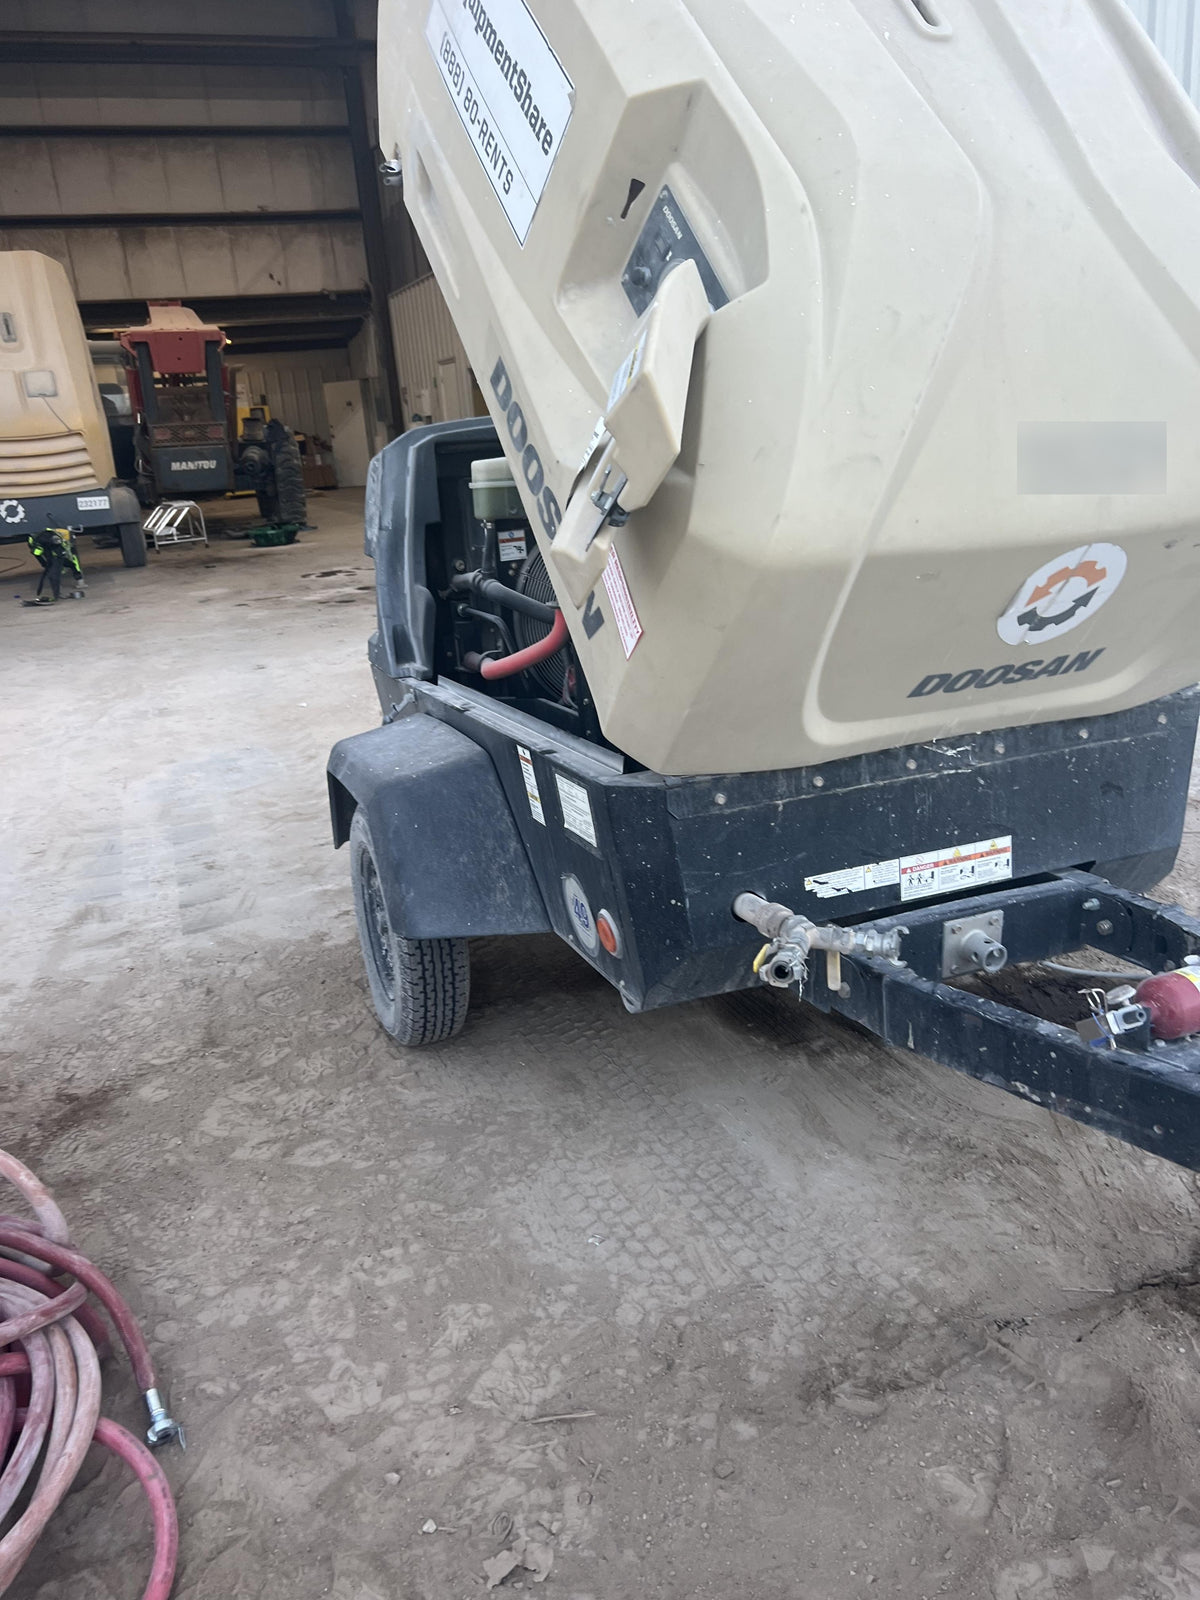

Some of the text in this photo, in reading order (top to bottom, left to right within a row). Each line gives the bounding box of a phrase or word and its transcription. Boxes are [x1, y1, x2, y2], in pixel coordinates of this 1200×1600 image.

[440, 31, 514, 195] (888) 80-RENTS
[171, 460, 217, 471] MANITOU
[906, 647, 1107, 698] DOOSAN
